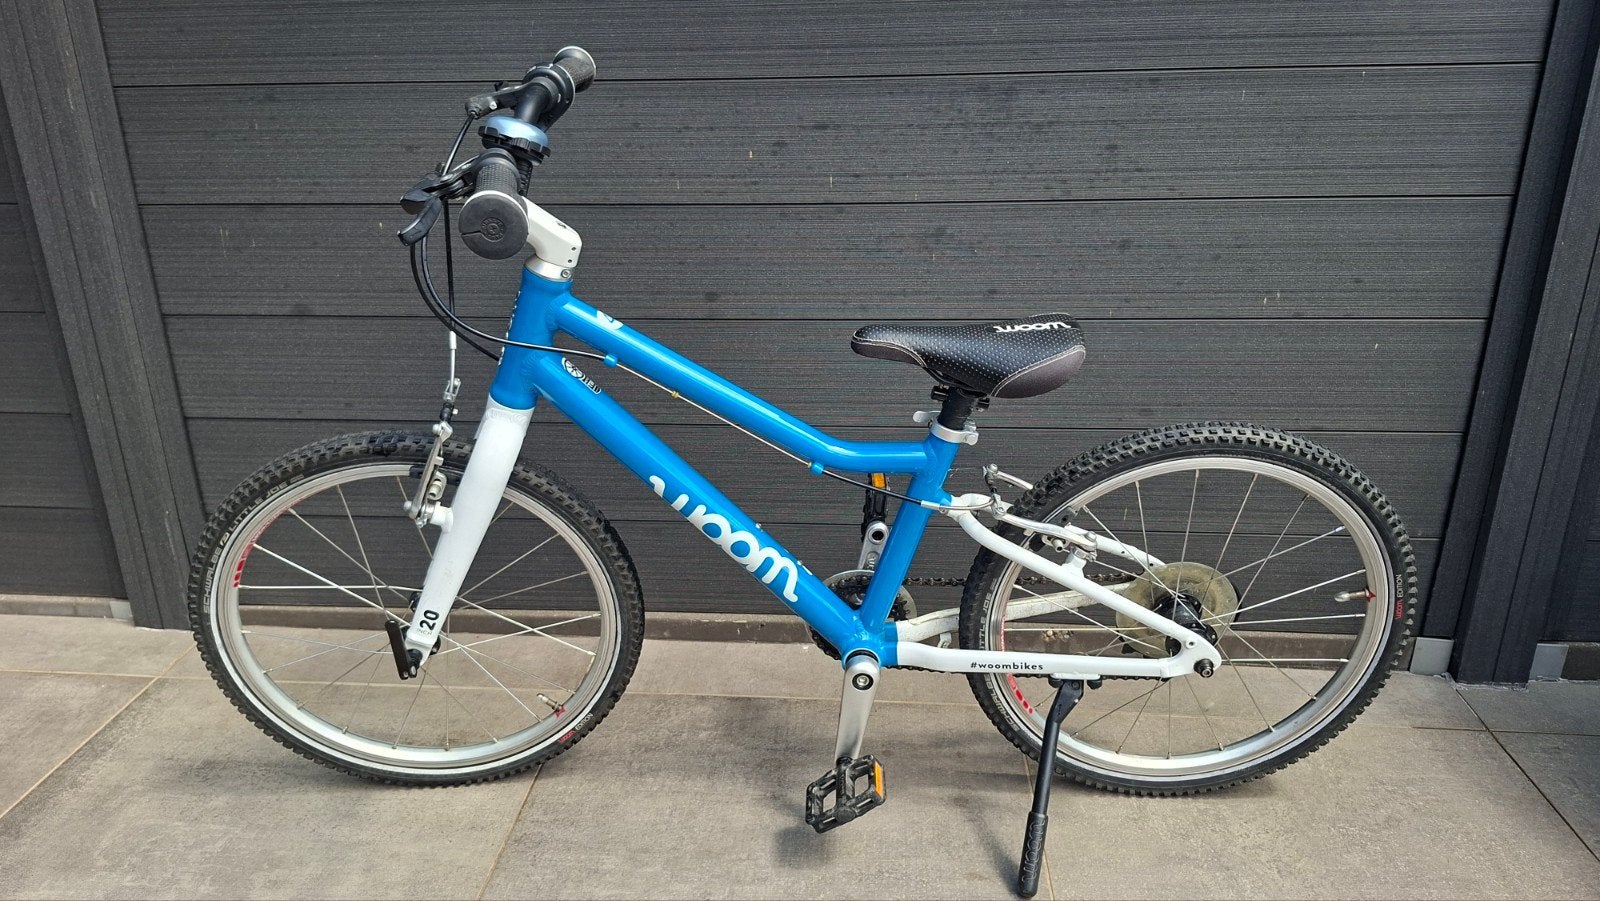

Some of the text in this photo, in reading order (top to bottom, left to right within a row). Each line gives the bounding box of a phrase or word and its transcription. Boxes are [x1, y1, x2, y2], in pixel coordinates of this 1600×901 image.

[993, 321, 1072, 333] woom
[203, 546, 222, 614] SCHWALBE
[228, 496, 264, 531] LITTLE
[266, 481, 288, 498] JOE
[983, 592, 992, 613] JOE
[419, 609, 440, 631] 20
[970, 661, 1044, 671] #woombikes
